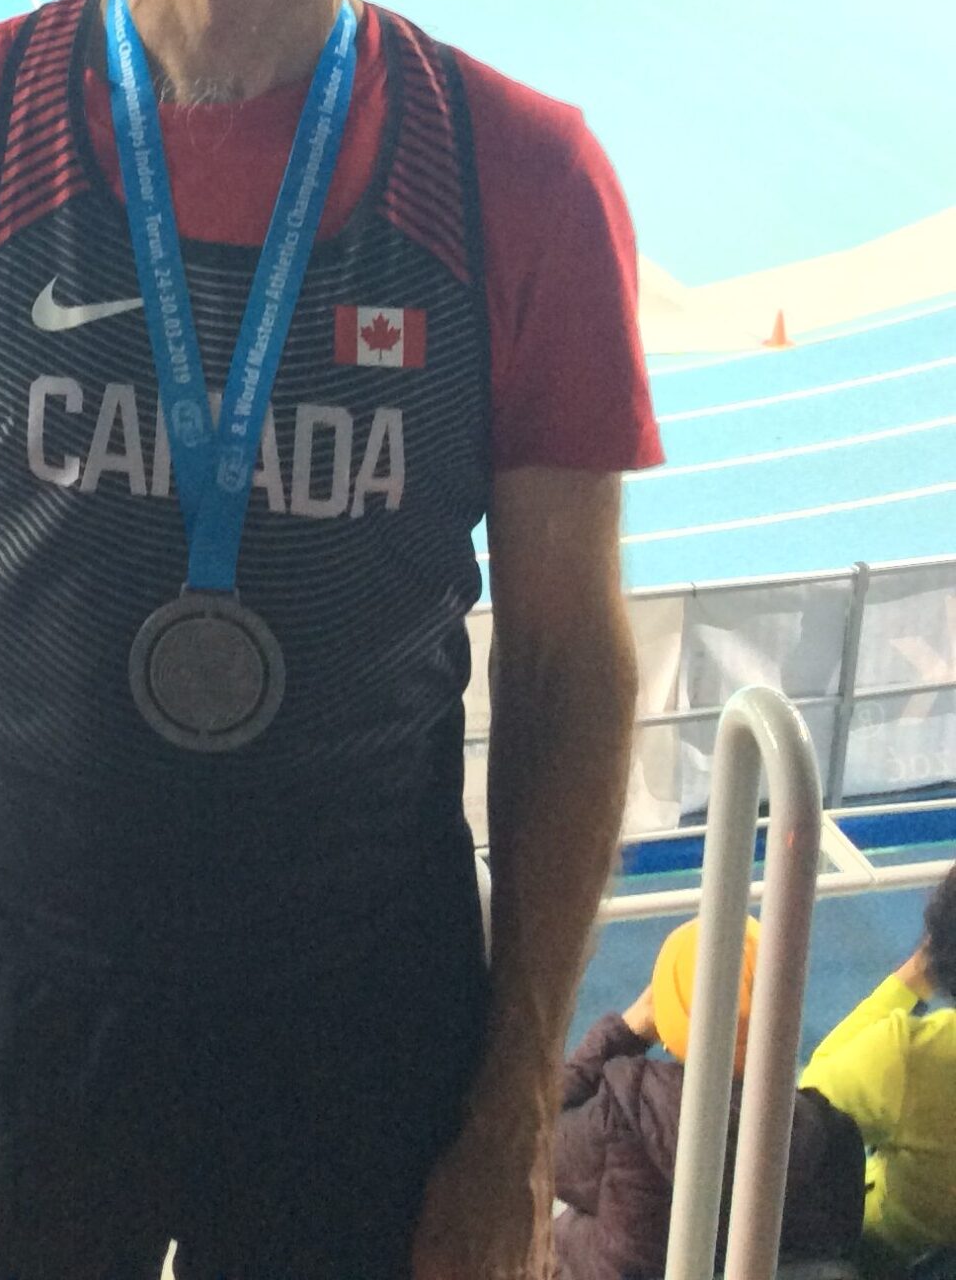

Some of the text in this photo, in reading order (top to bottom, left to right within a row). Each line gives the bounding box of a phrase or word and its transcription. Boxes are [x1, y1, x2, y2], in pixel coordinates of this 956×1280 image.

[117, 40, 147, 150] Championships
[317, 65, 343, 114] Indoor
[287, 114, 333, 227] Championships
[262, 228, 300, 300] Athletics
[246, 300, 277, 366] Masters
[232, 365, 263, 419] World
[27, 373, 406, 519] CADA
